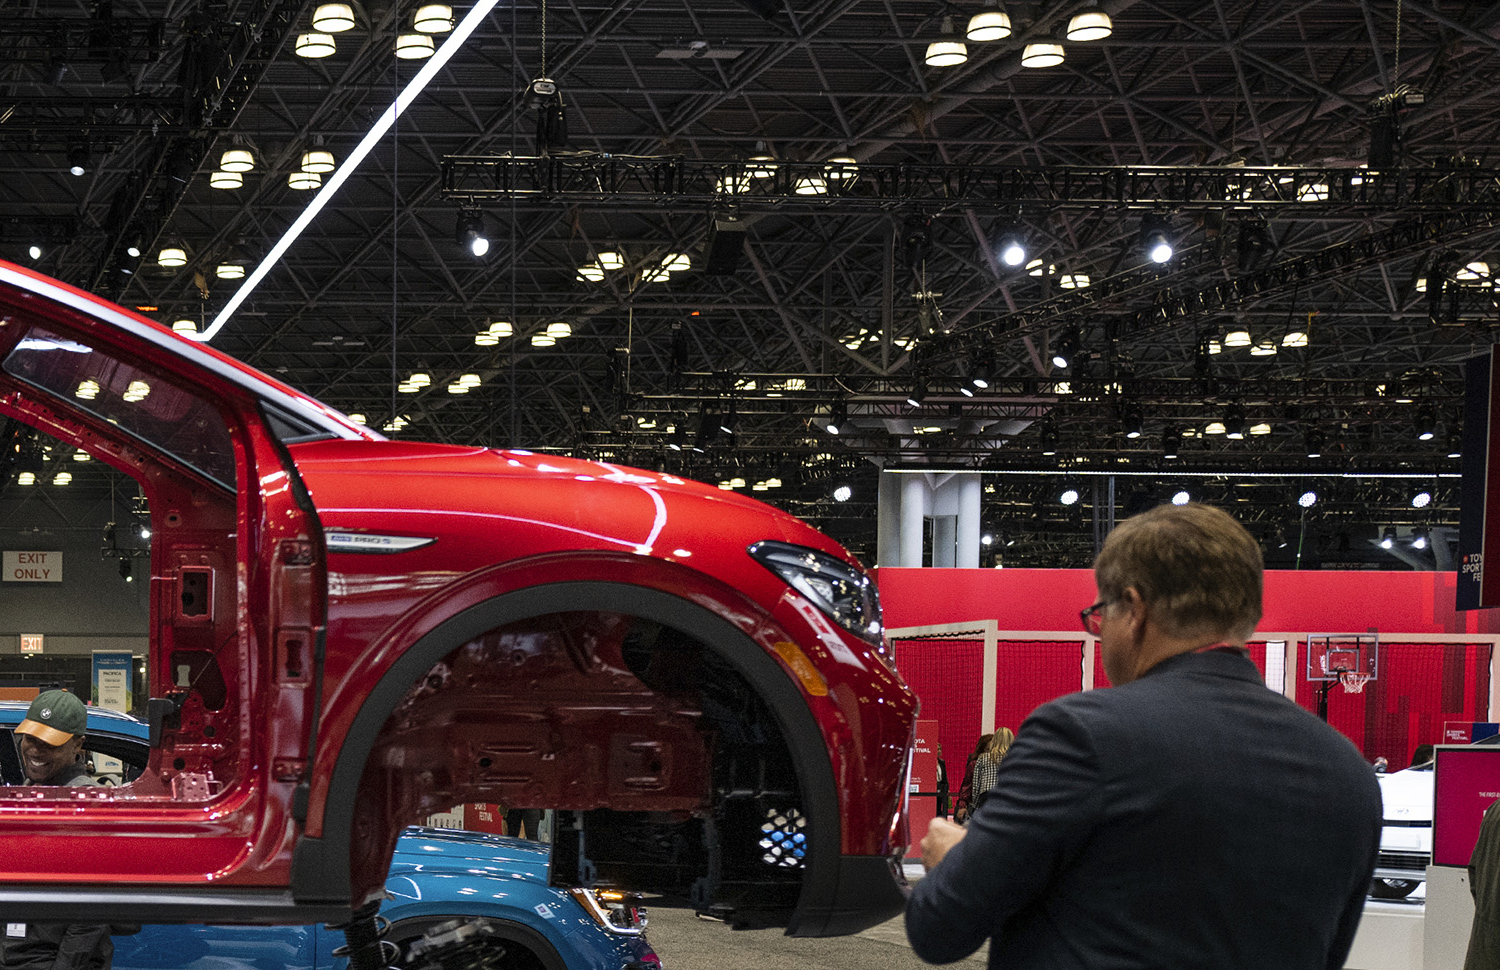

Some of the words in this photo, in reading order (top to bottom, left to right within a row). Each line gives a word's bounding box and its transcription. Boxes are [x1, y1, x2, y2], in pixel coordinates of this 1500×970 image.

[19, 553, 47, 563] EXIT
[14, 569, 50, 579] ONLY
[21, 637, 42, 650] EXIT
